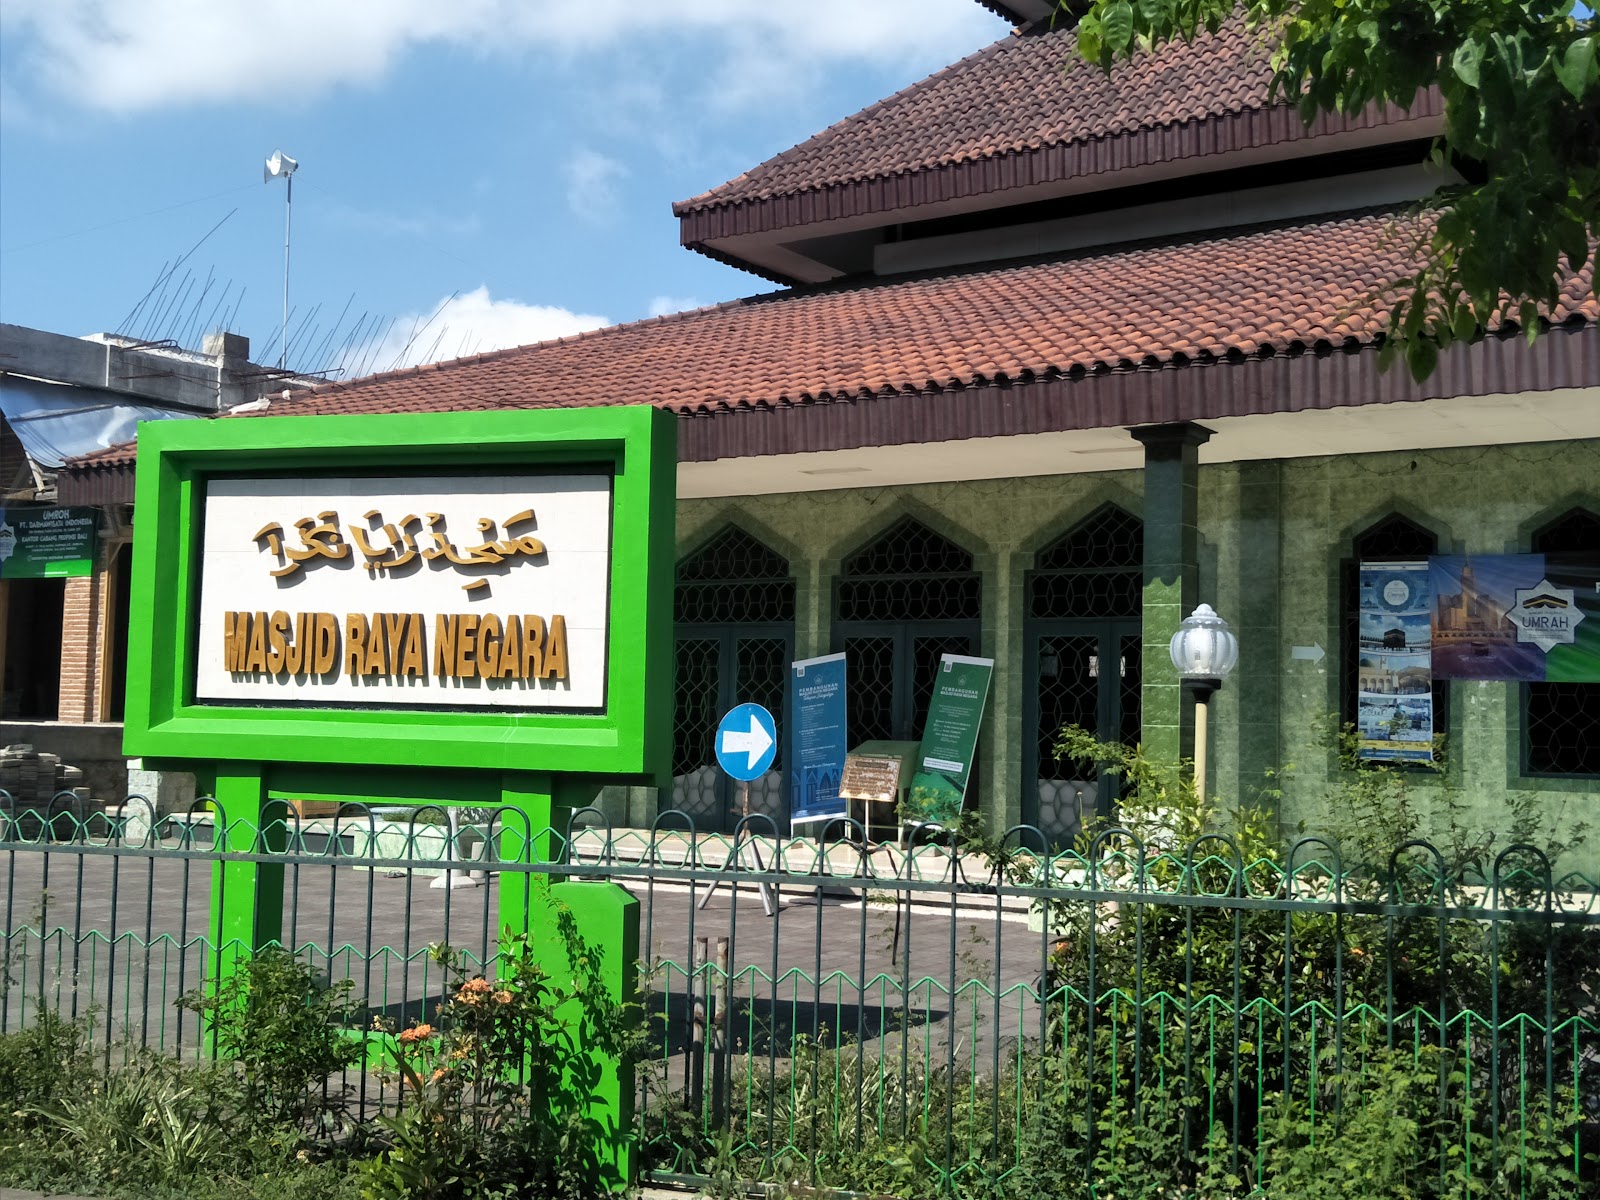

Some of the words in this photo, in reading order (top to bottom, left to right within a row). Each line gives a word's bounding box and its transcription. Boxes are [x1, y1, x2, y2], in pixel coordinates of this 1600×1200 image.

[43, 510, 70, 520] UMROH
[65, 518, 93, 527] INDONESIA
[40, 534, 58, 542] CABANG
[1522, 616, 1569, 629] UMRAH
[224, 610, 340, 676] MASJID
[345, 612, 425, 676] RAYA
[433, 612, 568, 679] NEGARA
